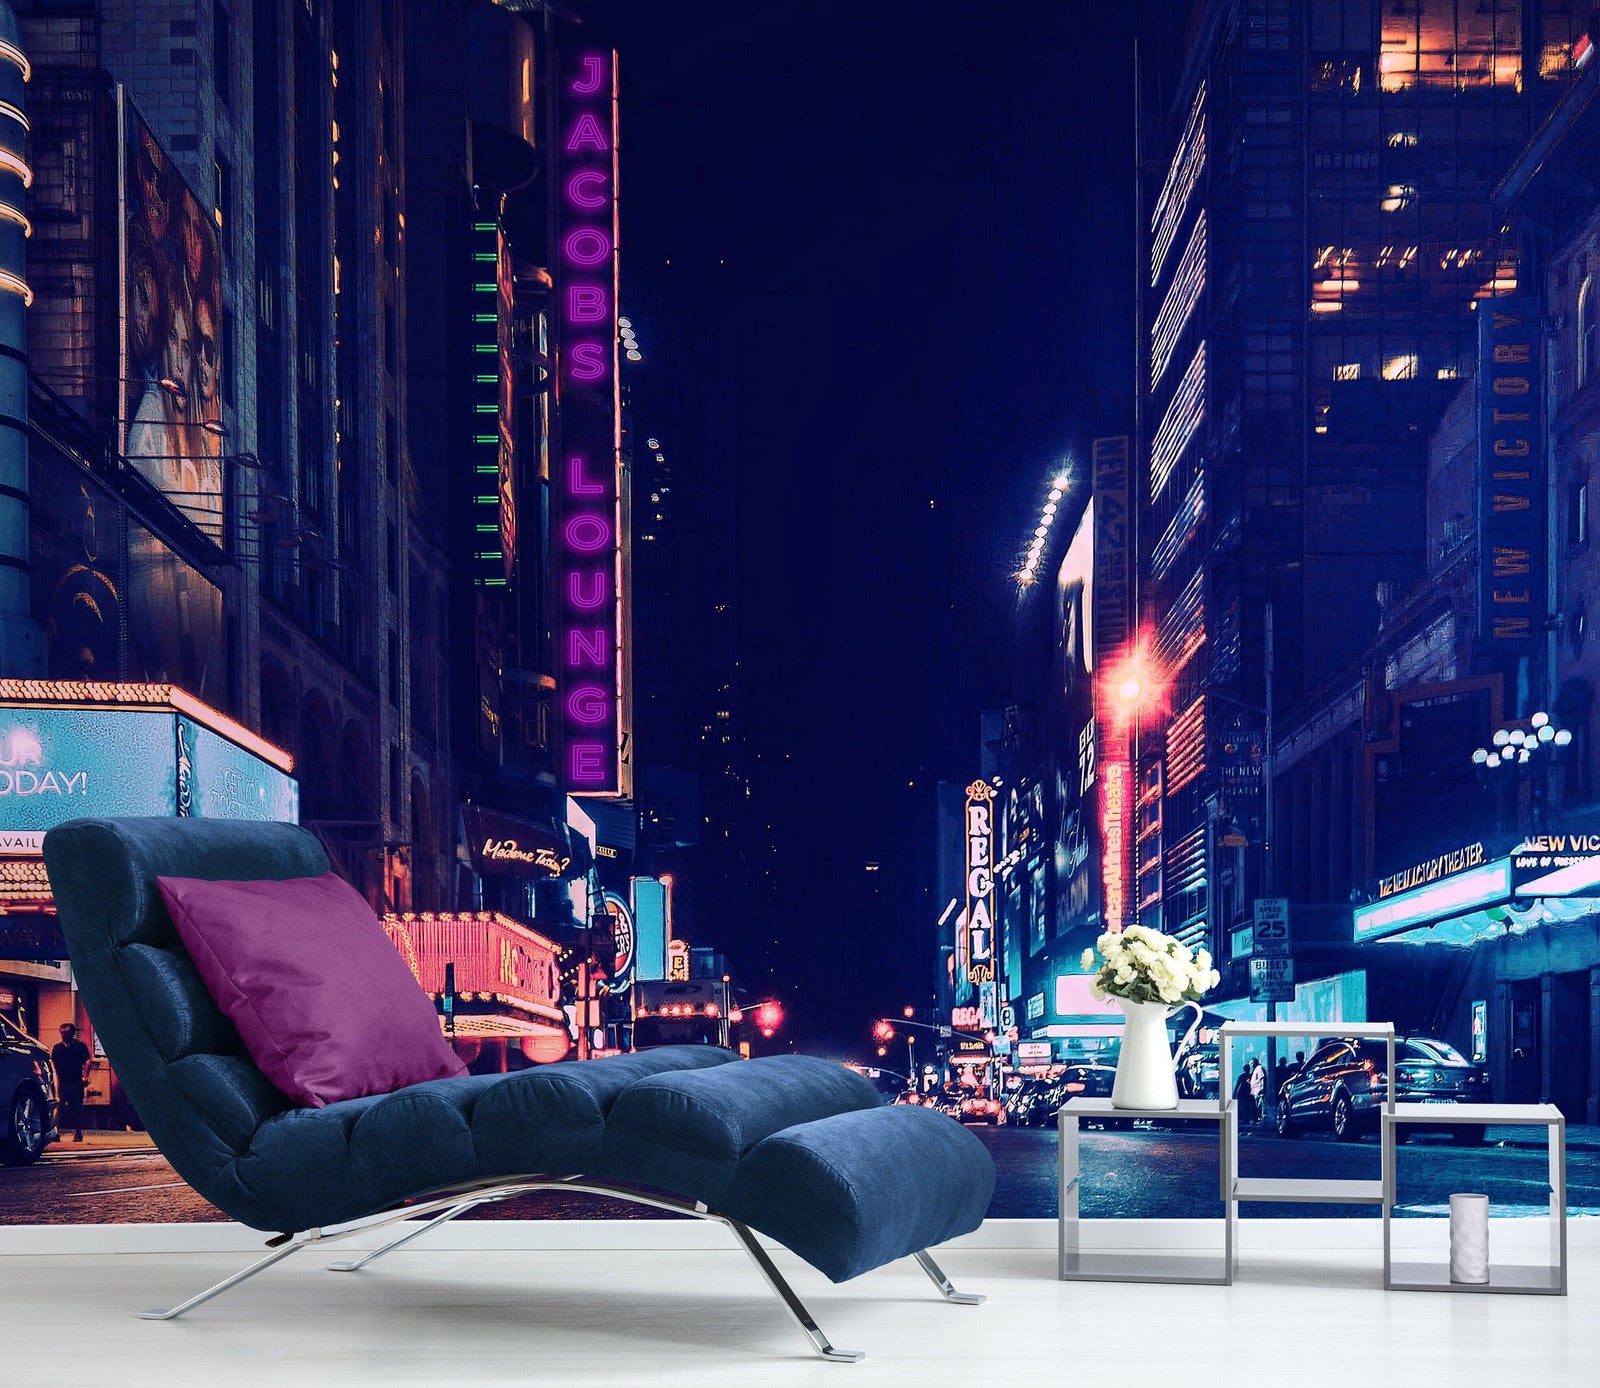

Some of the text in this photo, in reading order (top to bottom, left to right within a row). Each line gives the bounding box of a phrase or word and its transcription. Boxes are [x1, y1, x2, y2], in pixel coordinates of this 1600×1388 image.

[566, 57, 609, 780] JACOBS LOUNGE
[1493, 312, 1531, 639] NEW VICTORY
[0, 837, 39, 848] VAIL
[969, 805, 995, 960] REGAL
[1524, 834, 1600, 852] NEW VIC
[1257, 920, 1286, 938] 25
